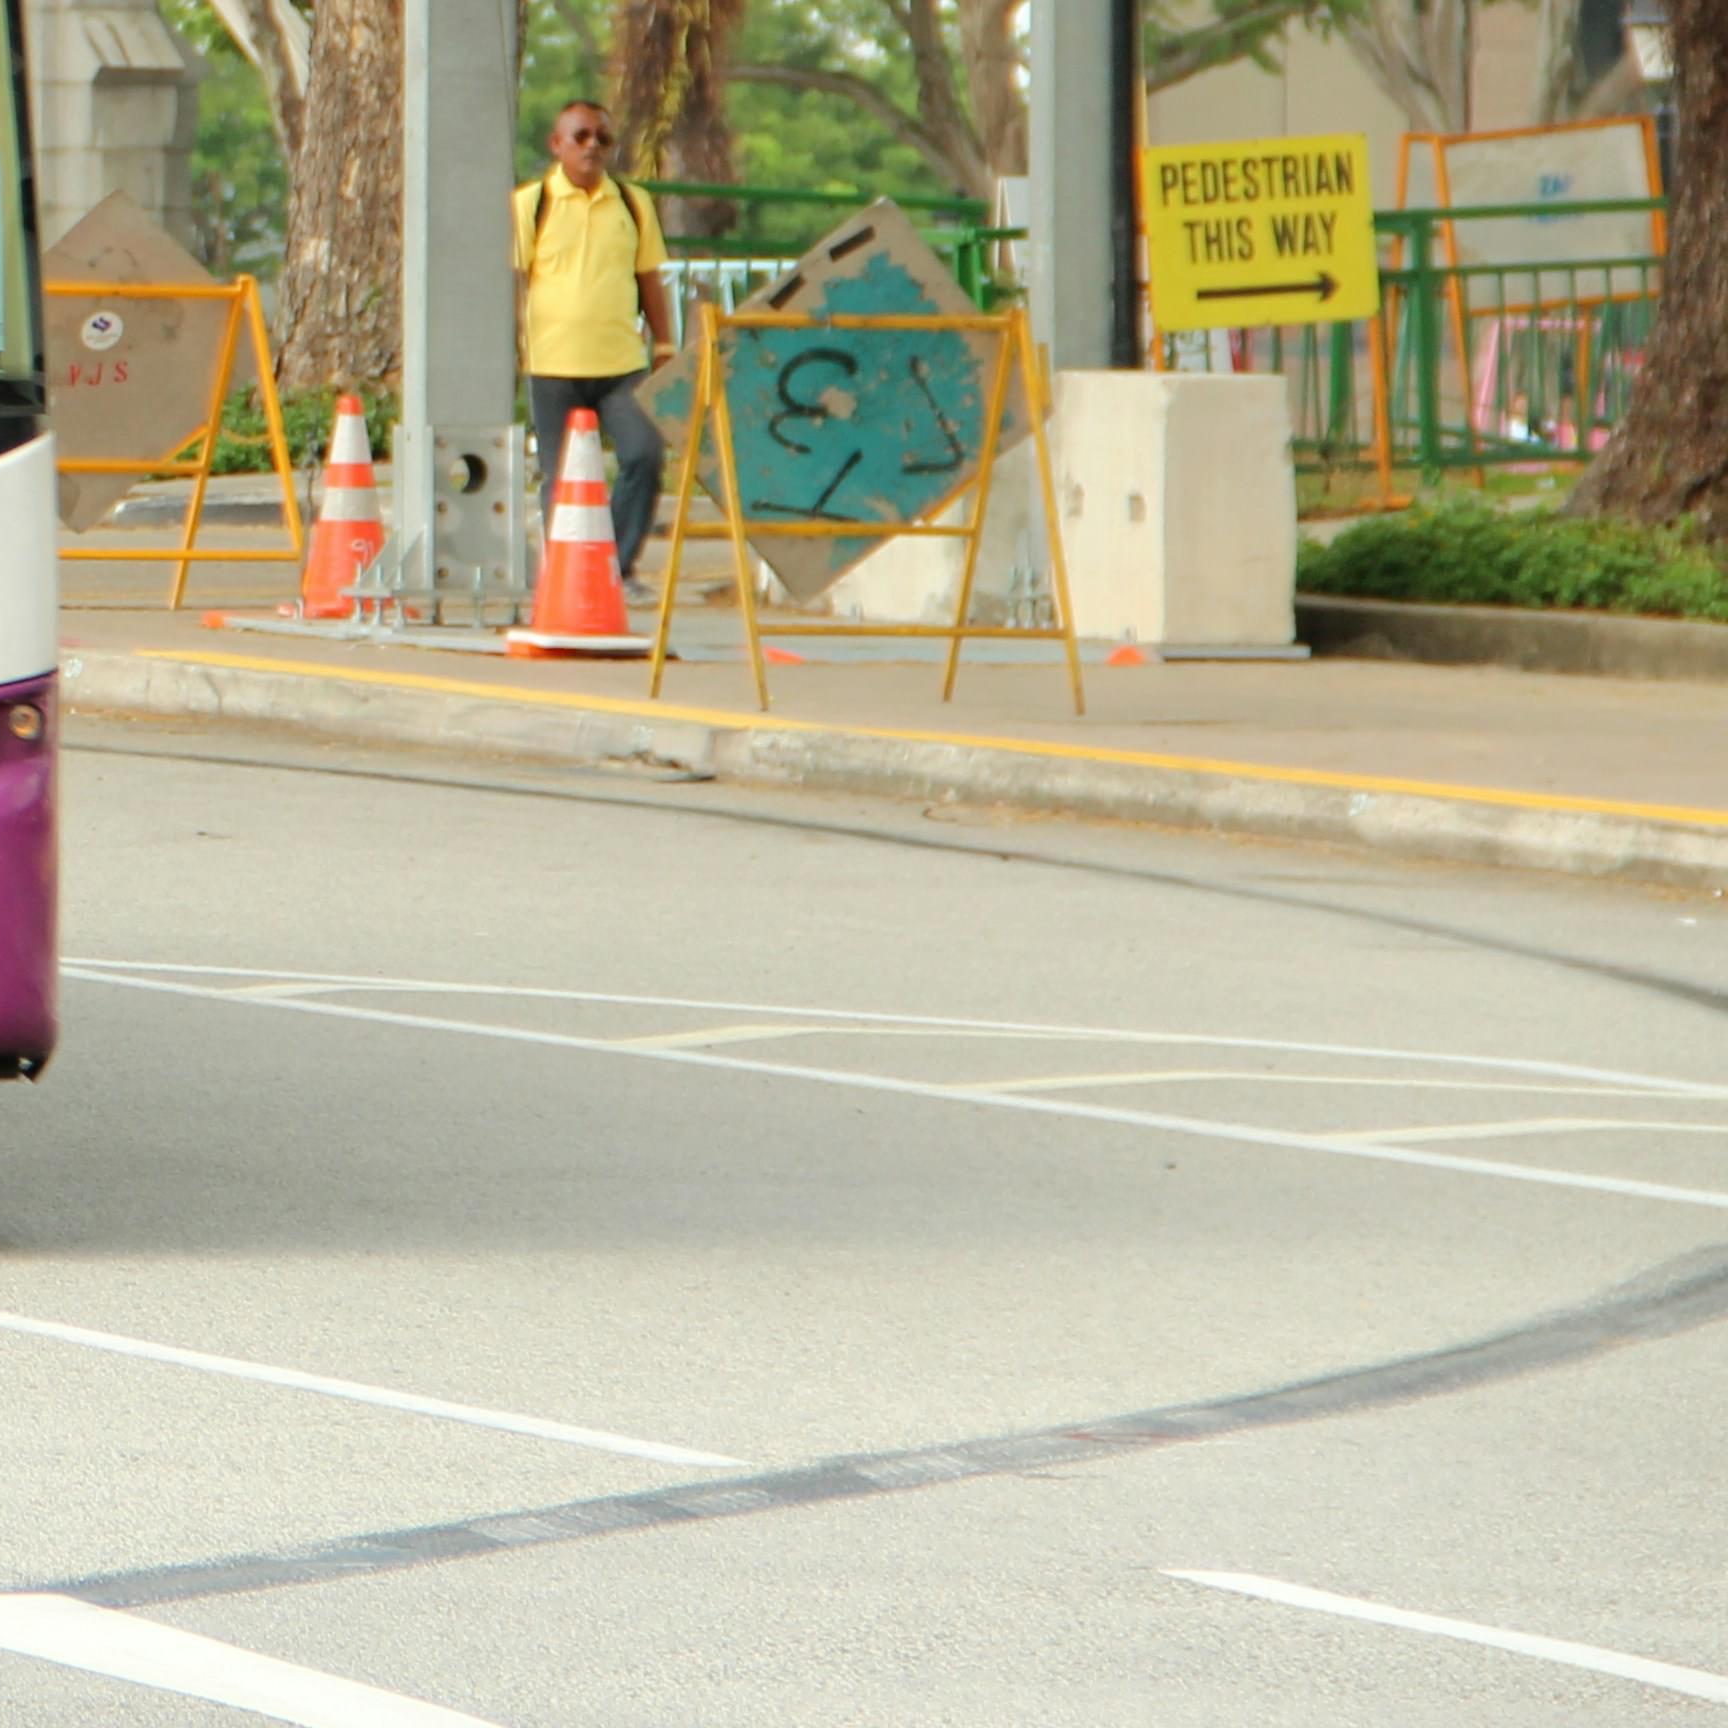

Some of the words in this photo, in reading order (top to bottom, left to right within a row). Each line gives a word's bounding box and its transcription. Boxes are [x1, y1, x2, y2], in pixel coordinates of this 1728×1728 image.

[1159, 151, 1356, 207] PEDESTRIAN
[1182, 216, 1255, 265] THIS
[1272, 211, 1338, 259] WAY
